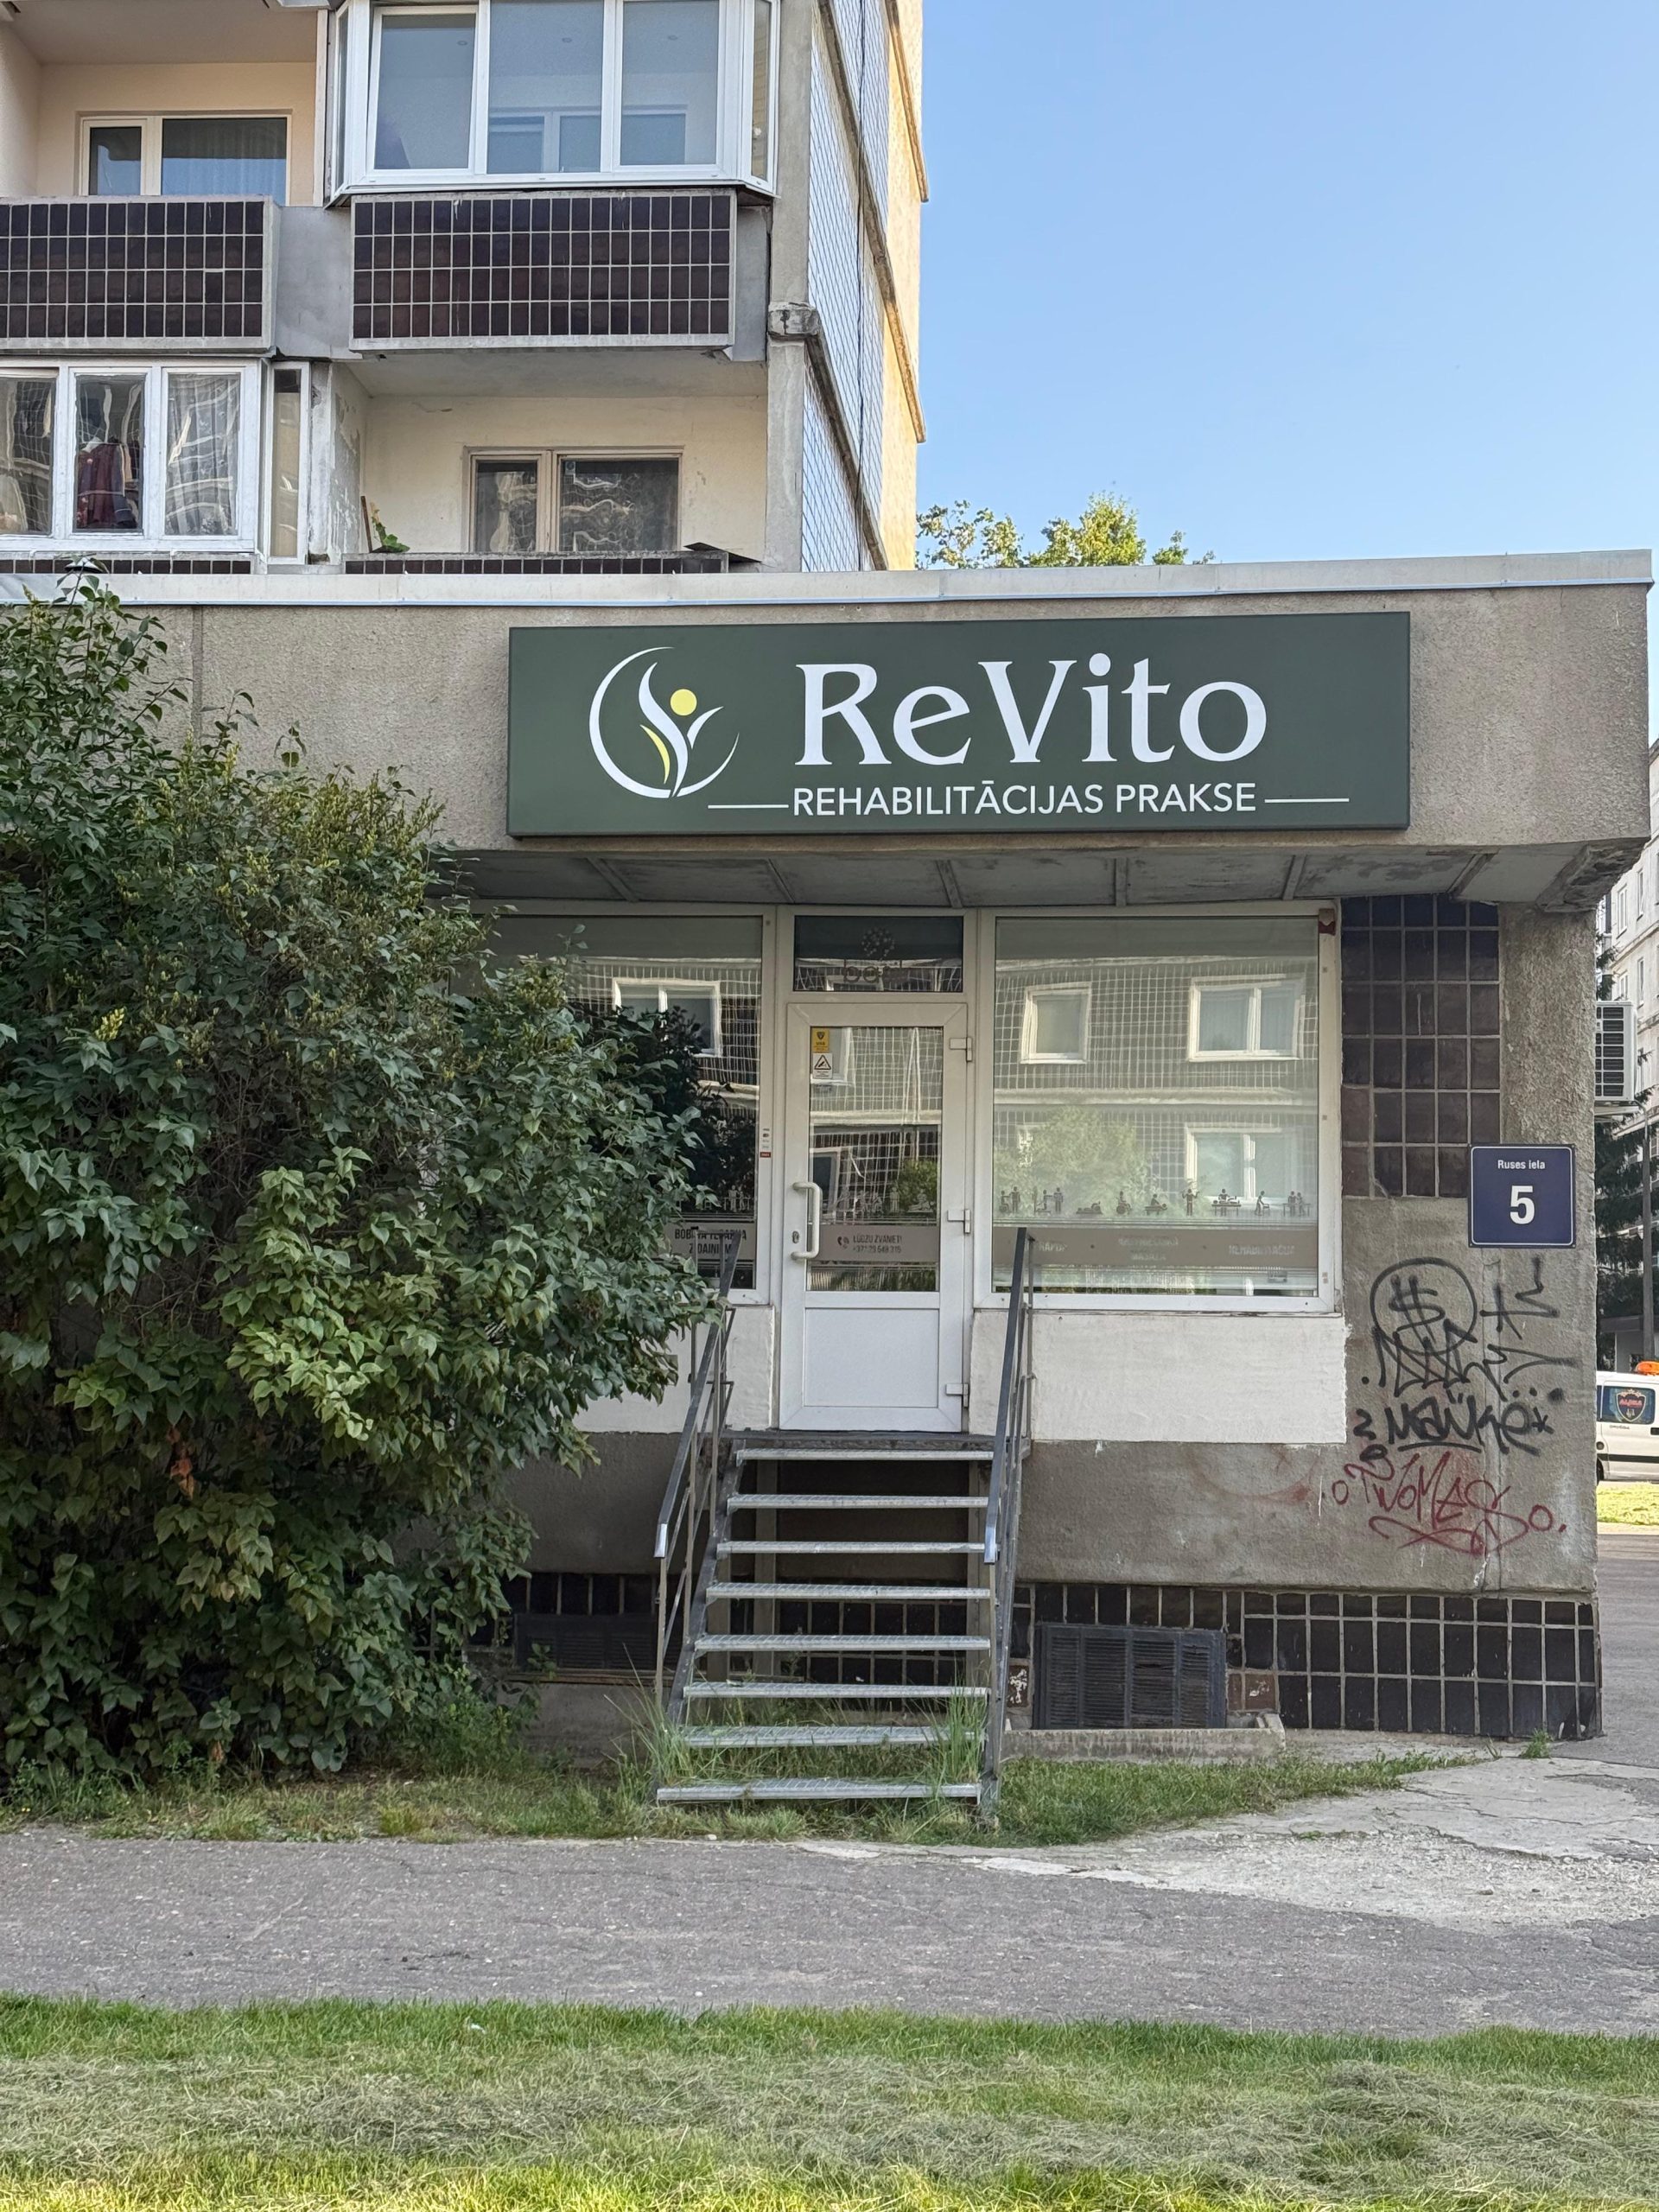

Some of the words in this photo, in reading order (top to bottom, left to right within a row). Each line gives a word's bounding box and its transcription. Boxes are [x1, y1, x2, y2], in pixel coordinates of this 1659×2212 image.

[795, 652, 1268, 766] ReVito
[793, 779, 1104, 817] REHABILITĀCIJAS
[1116, 782, 1256, 814] PRAKSE
[1497, 1160, 1526, 1170] Ruses
[1529, 1160, 1546, 1170] iela
[1510, 1185, 1535, 1224] 5
